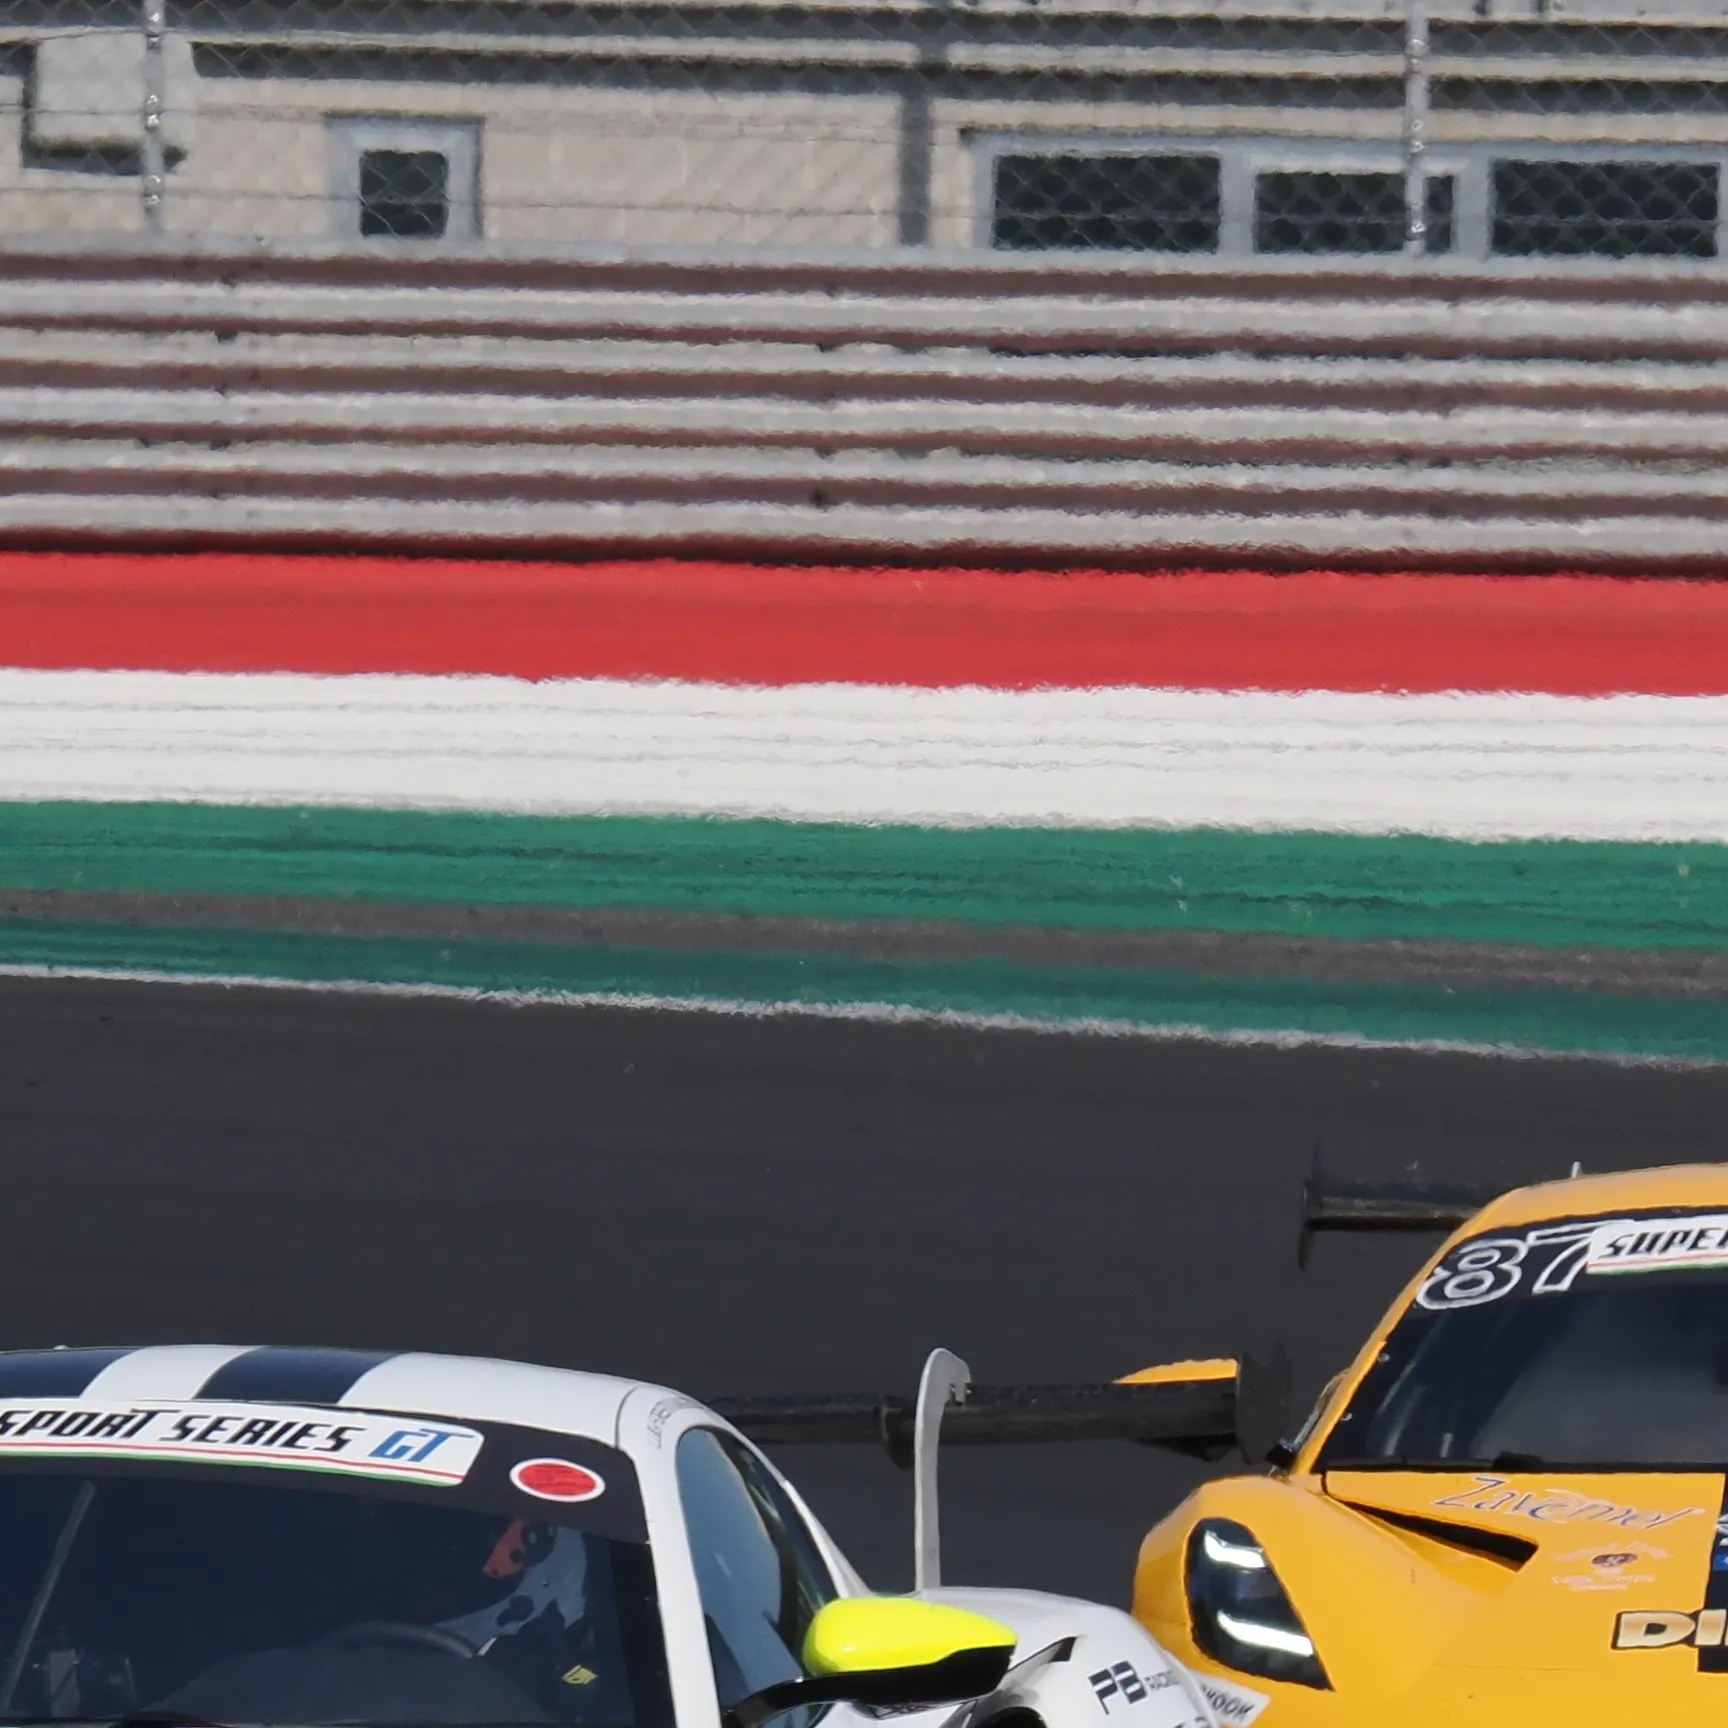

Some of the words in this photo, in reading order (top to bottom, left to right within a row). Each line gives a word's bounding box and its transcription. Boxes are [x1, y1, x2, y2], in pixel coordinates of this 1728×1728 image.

[1416, 1219, 1617, 1310] 87
[159, 1415, 366, 1452] SERIES
[368, 1428, 475, 1463] GT
